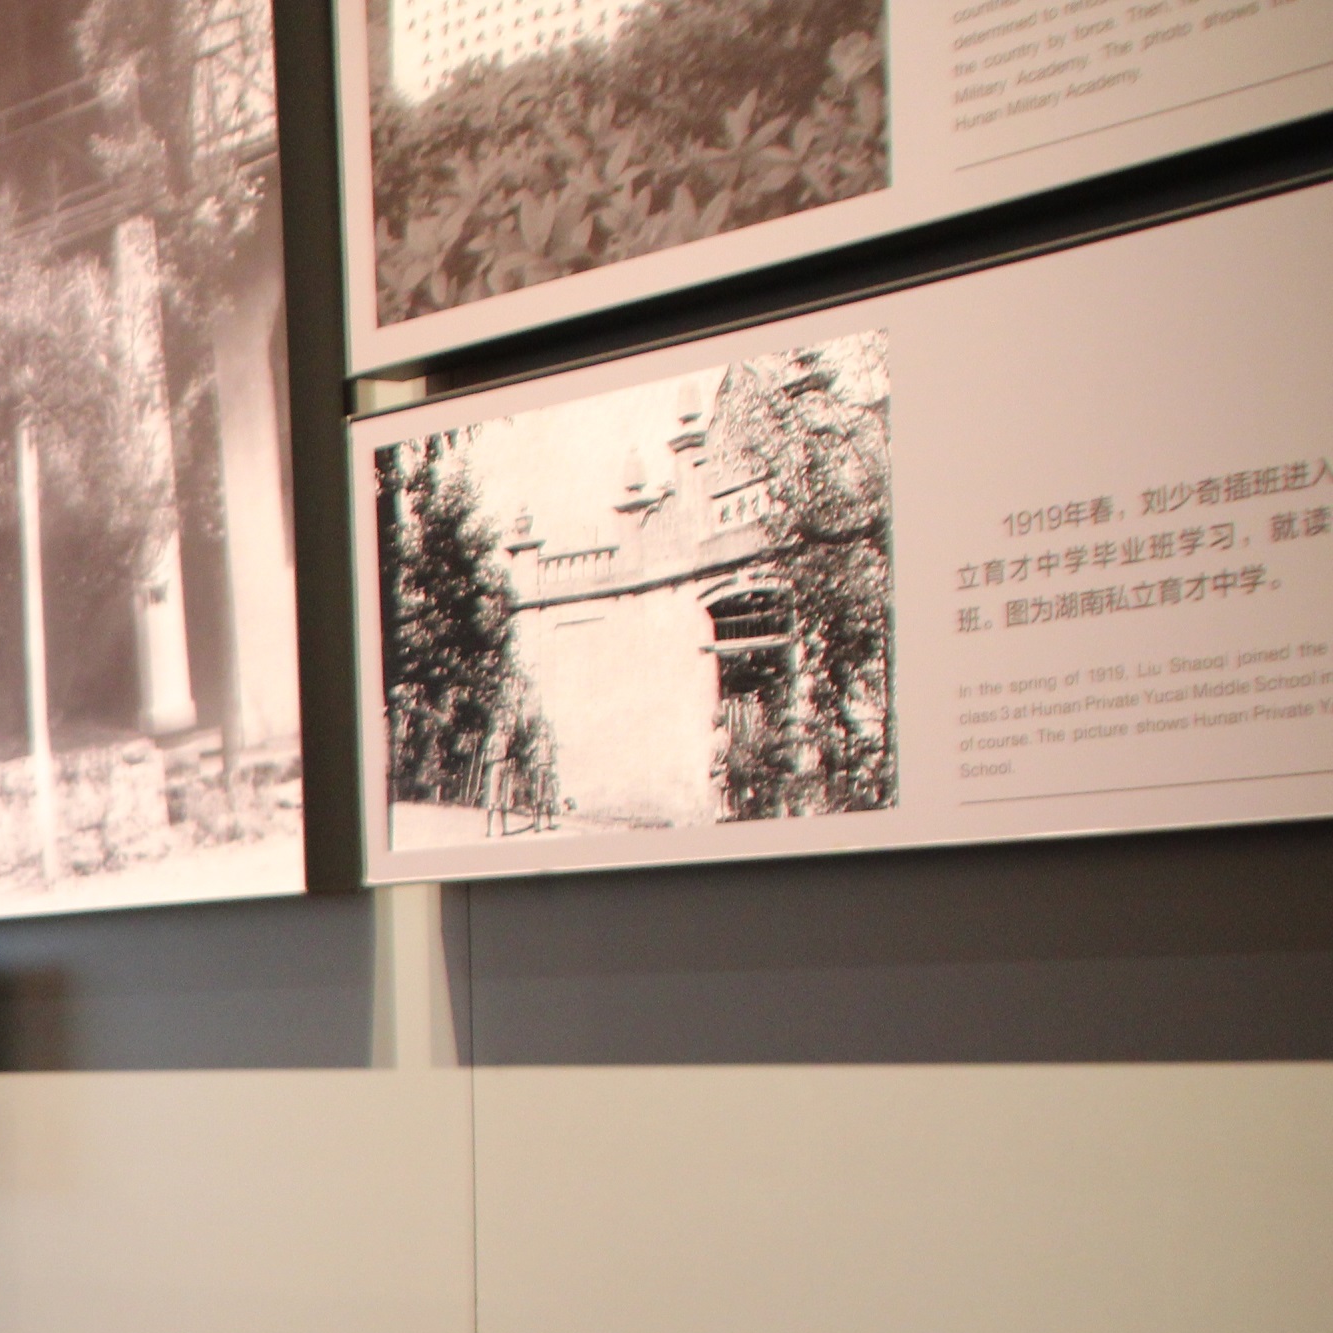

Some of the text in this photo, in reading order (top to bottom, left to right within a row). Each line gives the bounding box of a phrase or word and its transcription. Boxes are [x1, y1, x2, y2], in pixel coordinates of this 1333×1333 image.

[983, 42, 1039, 69] country
[957, 563, 1282, 633] 班。图为湖南私立育才中学。
[960, 684, 972, 698] In
[979, 681, 1003, 695] the
[1010, 675, 1057, 694] spring
[1065, 670, 1080, 686] of
[1138, 662, 1162, 678] Liu
[1237, 644, 1290, 668] joined
[1299, 641, 1328, 658] the
[960, 710, 997, 725] class
[1001, 705, 1010, 720] 3
[1013, 704, 1028, 719] at
[1031, 700, 1081, 717] Hunan
[1085, 693, 1140, 711] Private
[1193, 679, 1251, 699] Middle
[1255, 671, 1316, 692] School
[960, 737, 973, 752] of
[1039, 727, 1065, 743] The
[1074, 723, 1129, 743] picture
[1137, 717, 1189, 734] shows
[1193, 710, 1249, 728] Hunan
[1253, 701, 1314, 721] Private
